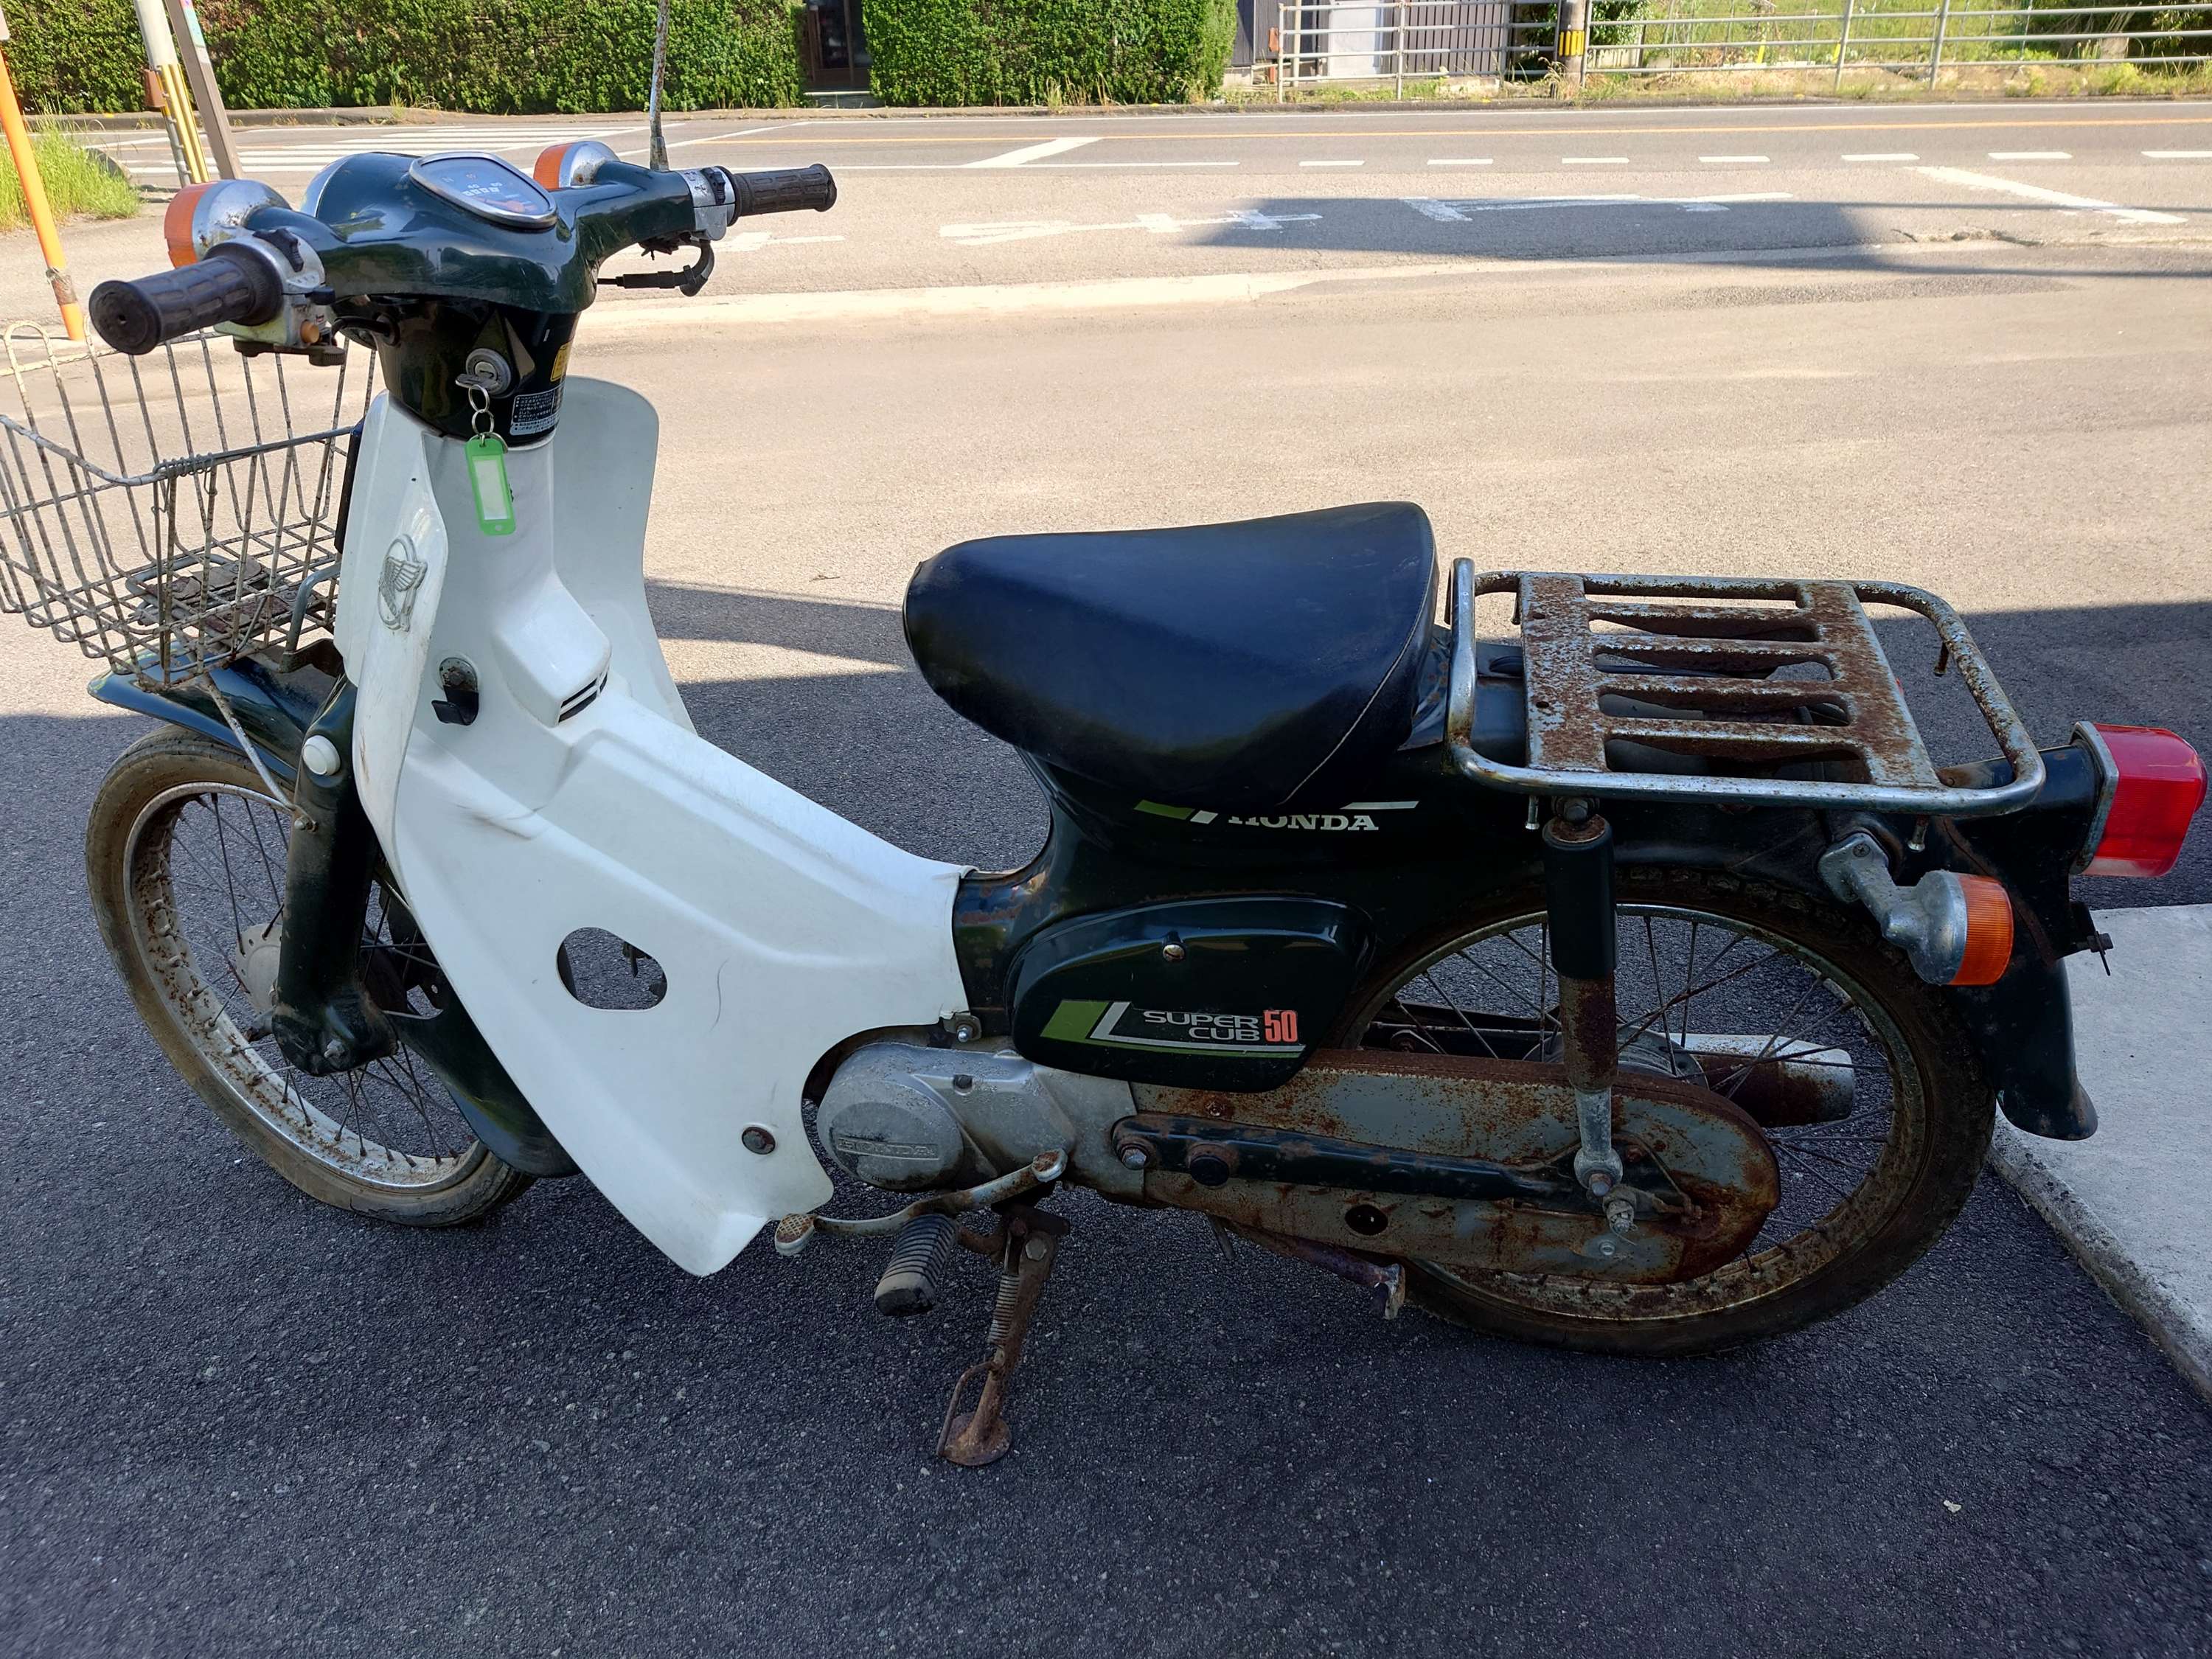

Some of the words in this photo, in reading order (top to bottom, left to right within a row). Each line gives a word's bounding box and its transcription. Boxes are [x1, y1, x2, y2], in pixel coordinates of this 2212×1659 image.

[1144, 1011, 1259, 1029] SUPER
[1263, 1009, 1298, 1043] 50
[1189, 1027, 1260, 1042] CUB
